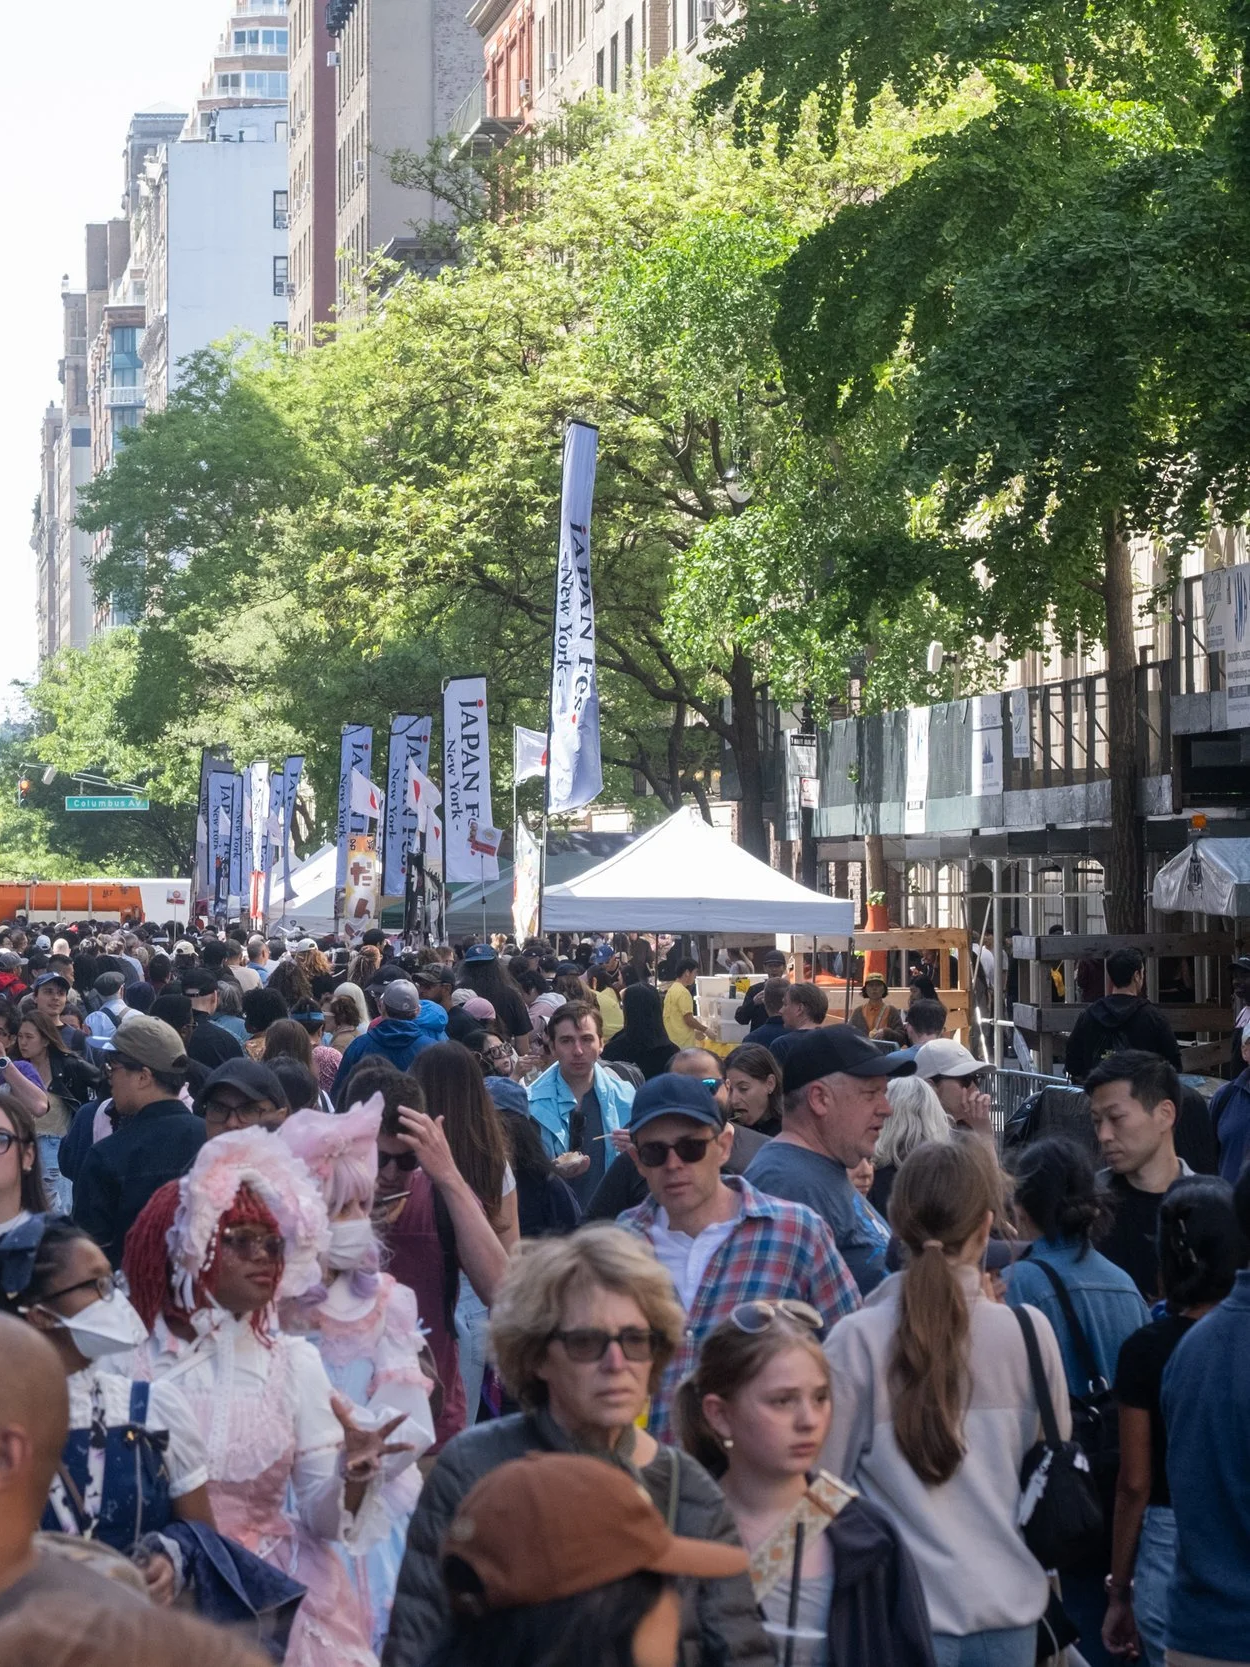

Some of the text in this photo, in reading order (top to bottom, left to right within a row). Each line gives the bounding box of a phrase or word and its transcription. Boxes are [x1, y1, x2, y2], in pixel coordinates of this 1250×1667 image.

[560, 566, 574, 616] New
[570, 521, 593, 642] JAPAN
[556, 623, 573, 673] York
[446, 740, 456, 776] New
[459, 698, 484, 792] JAPAN
[340, 774, 348, 805] New
[389, 768, 400, 800] New
[449, 781, 462, 819] York
[74, 800, 125, 808] Columbus
[339, 808, 347, 839] York
[387, 806, 397, 839] York
